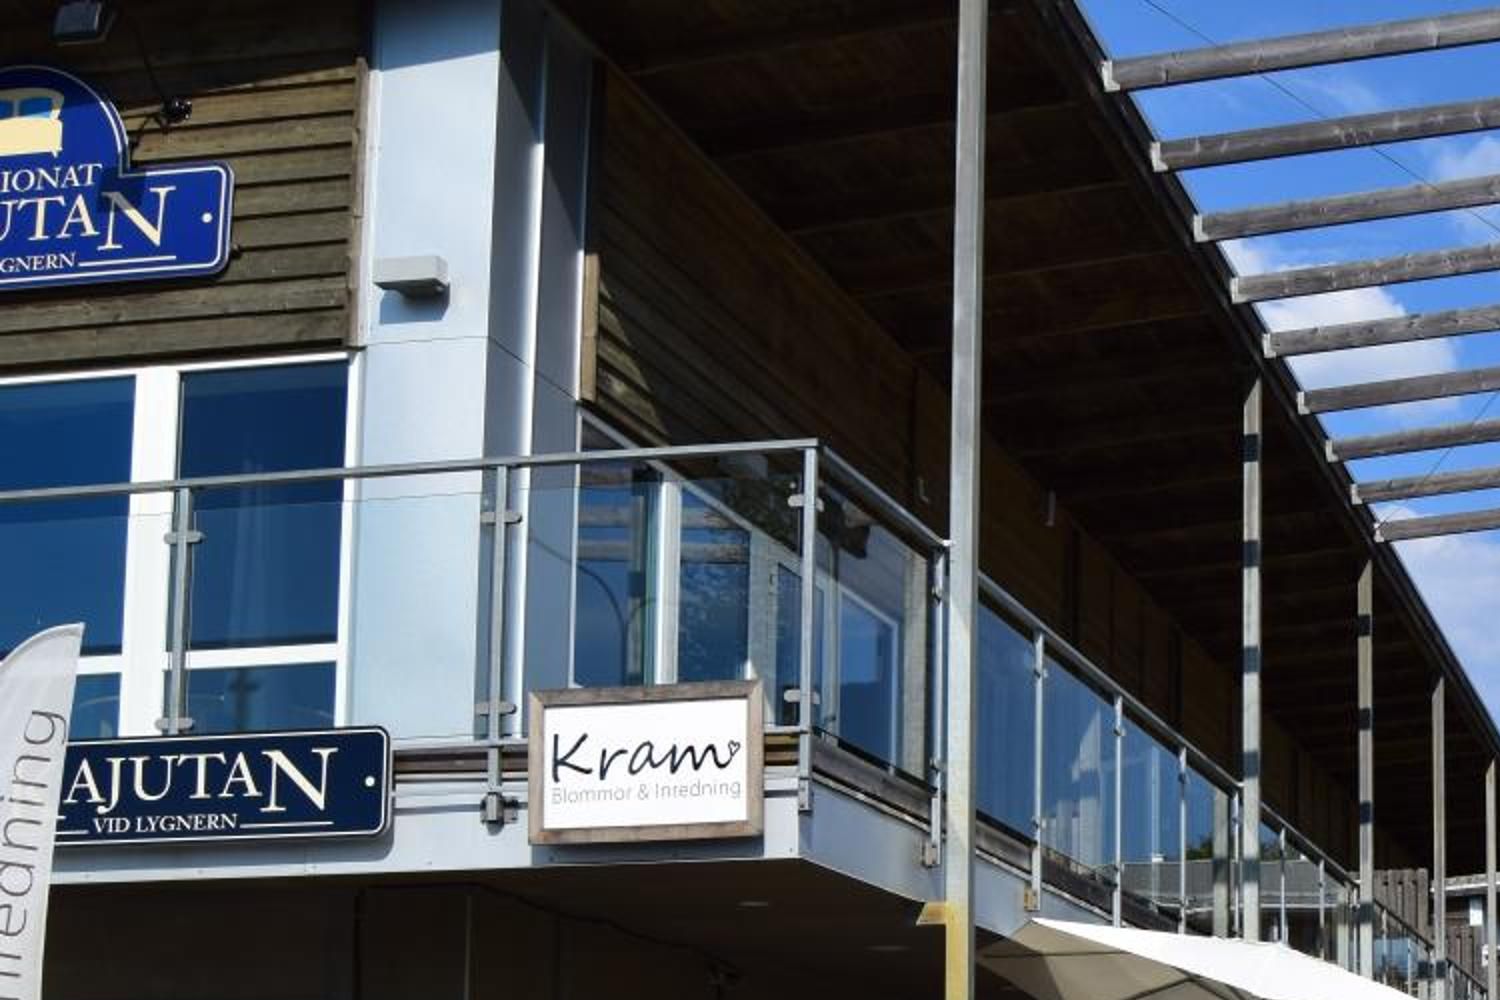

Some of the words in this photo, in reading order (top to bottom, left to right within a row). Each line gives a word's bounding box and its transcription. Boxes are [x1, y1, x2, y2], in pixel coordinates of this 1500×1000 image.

[0, 163, 103, 194] IONAT
[0, 251, 76, 273] GNERN
[551, 732, 740, 783] Kram
[59, 747, 339, 820] AJUTAN
[551, 784, 632, 805] Blommor
[637, 782, 650, 801] &
[655, 779, 741, 800] Inredning
[93, 816, 131, 834] VID
[135, 813, 238, 833] LYGNERN
